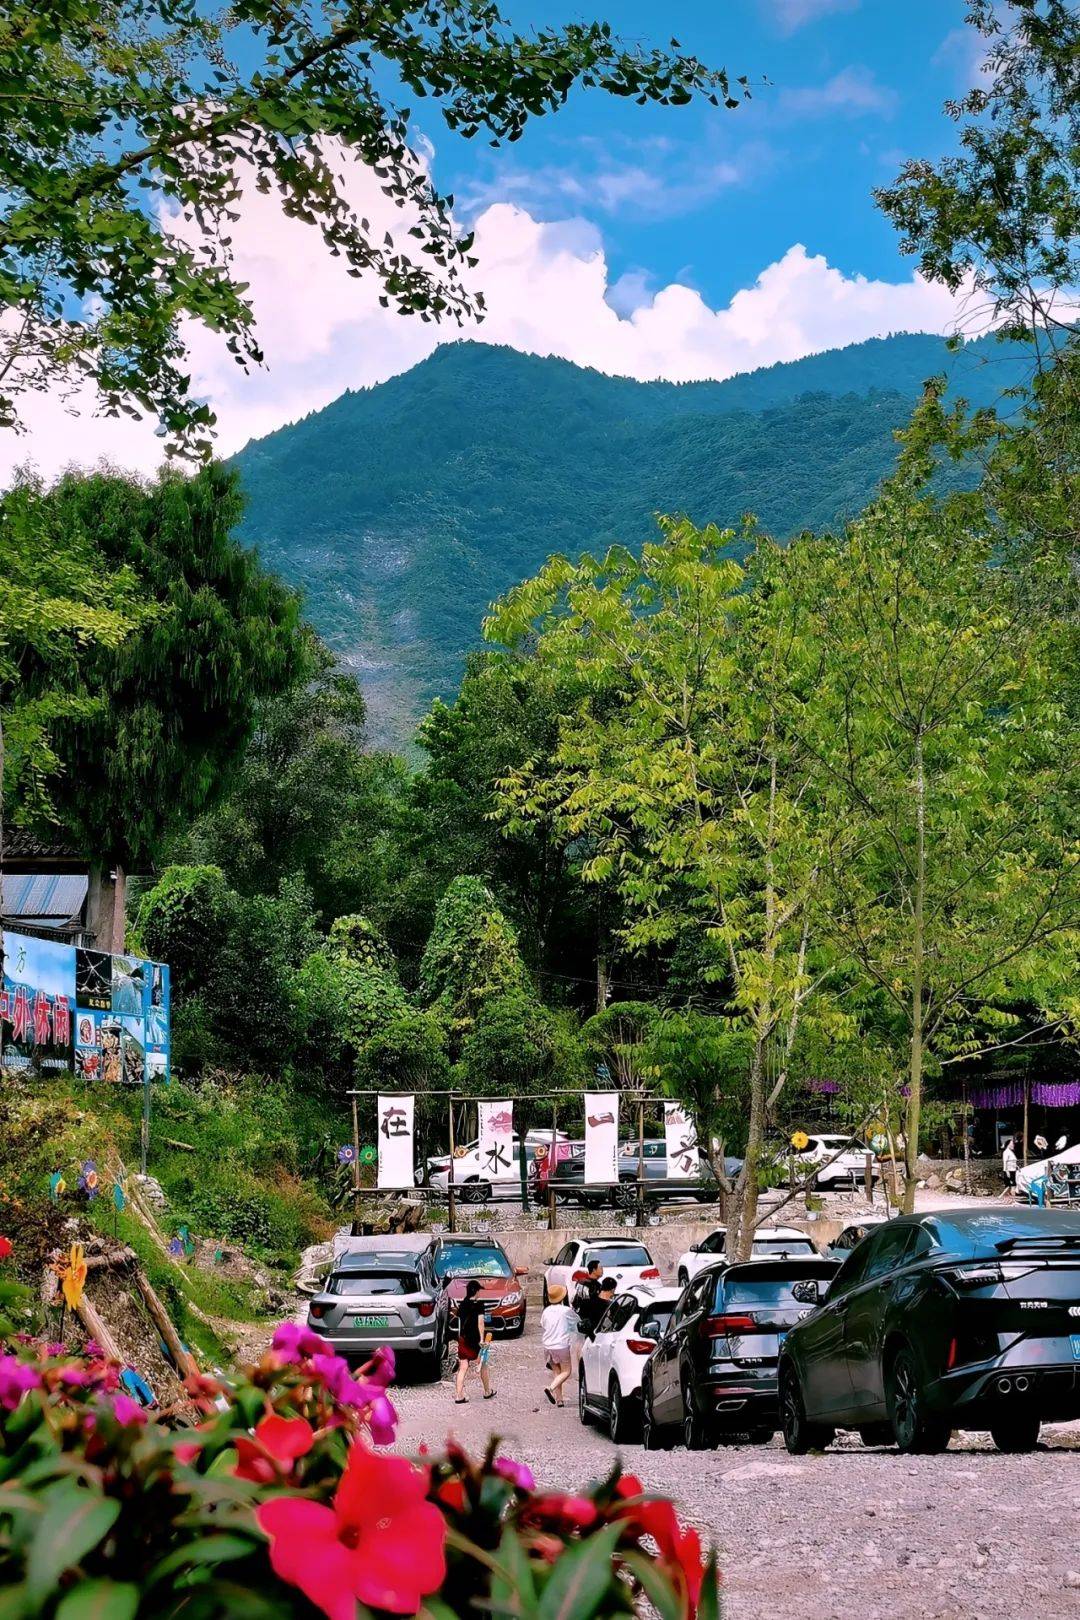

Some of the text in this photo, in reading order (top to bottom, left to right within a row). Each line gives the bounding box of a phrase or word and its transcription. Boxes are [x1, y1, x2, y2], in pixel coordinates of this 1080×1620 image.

[380, 1106, 411, 1139] 在
[481, 1140, 512, 1175] 水
[670, 1140, 695, 1173] 方
